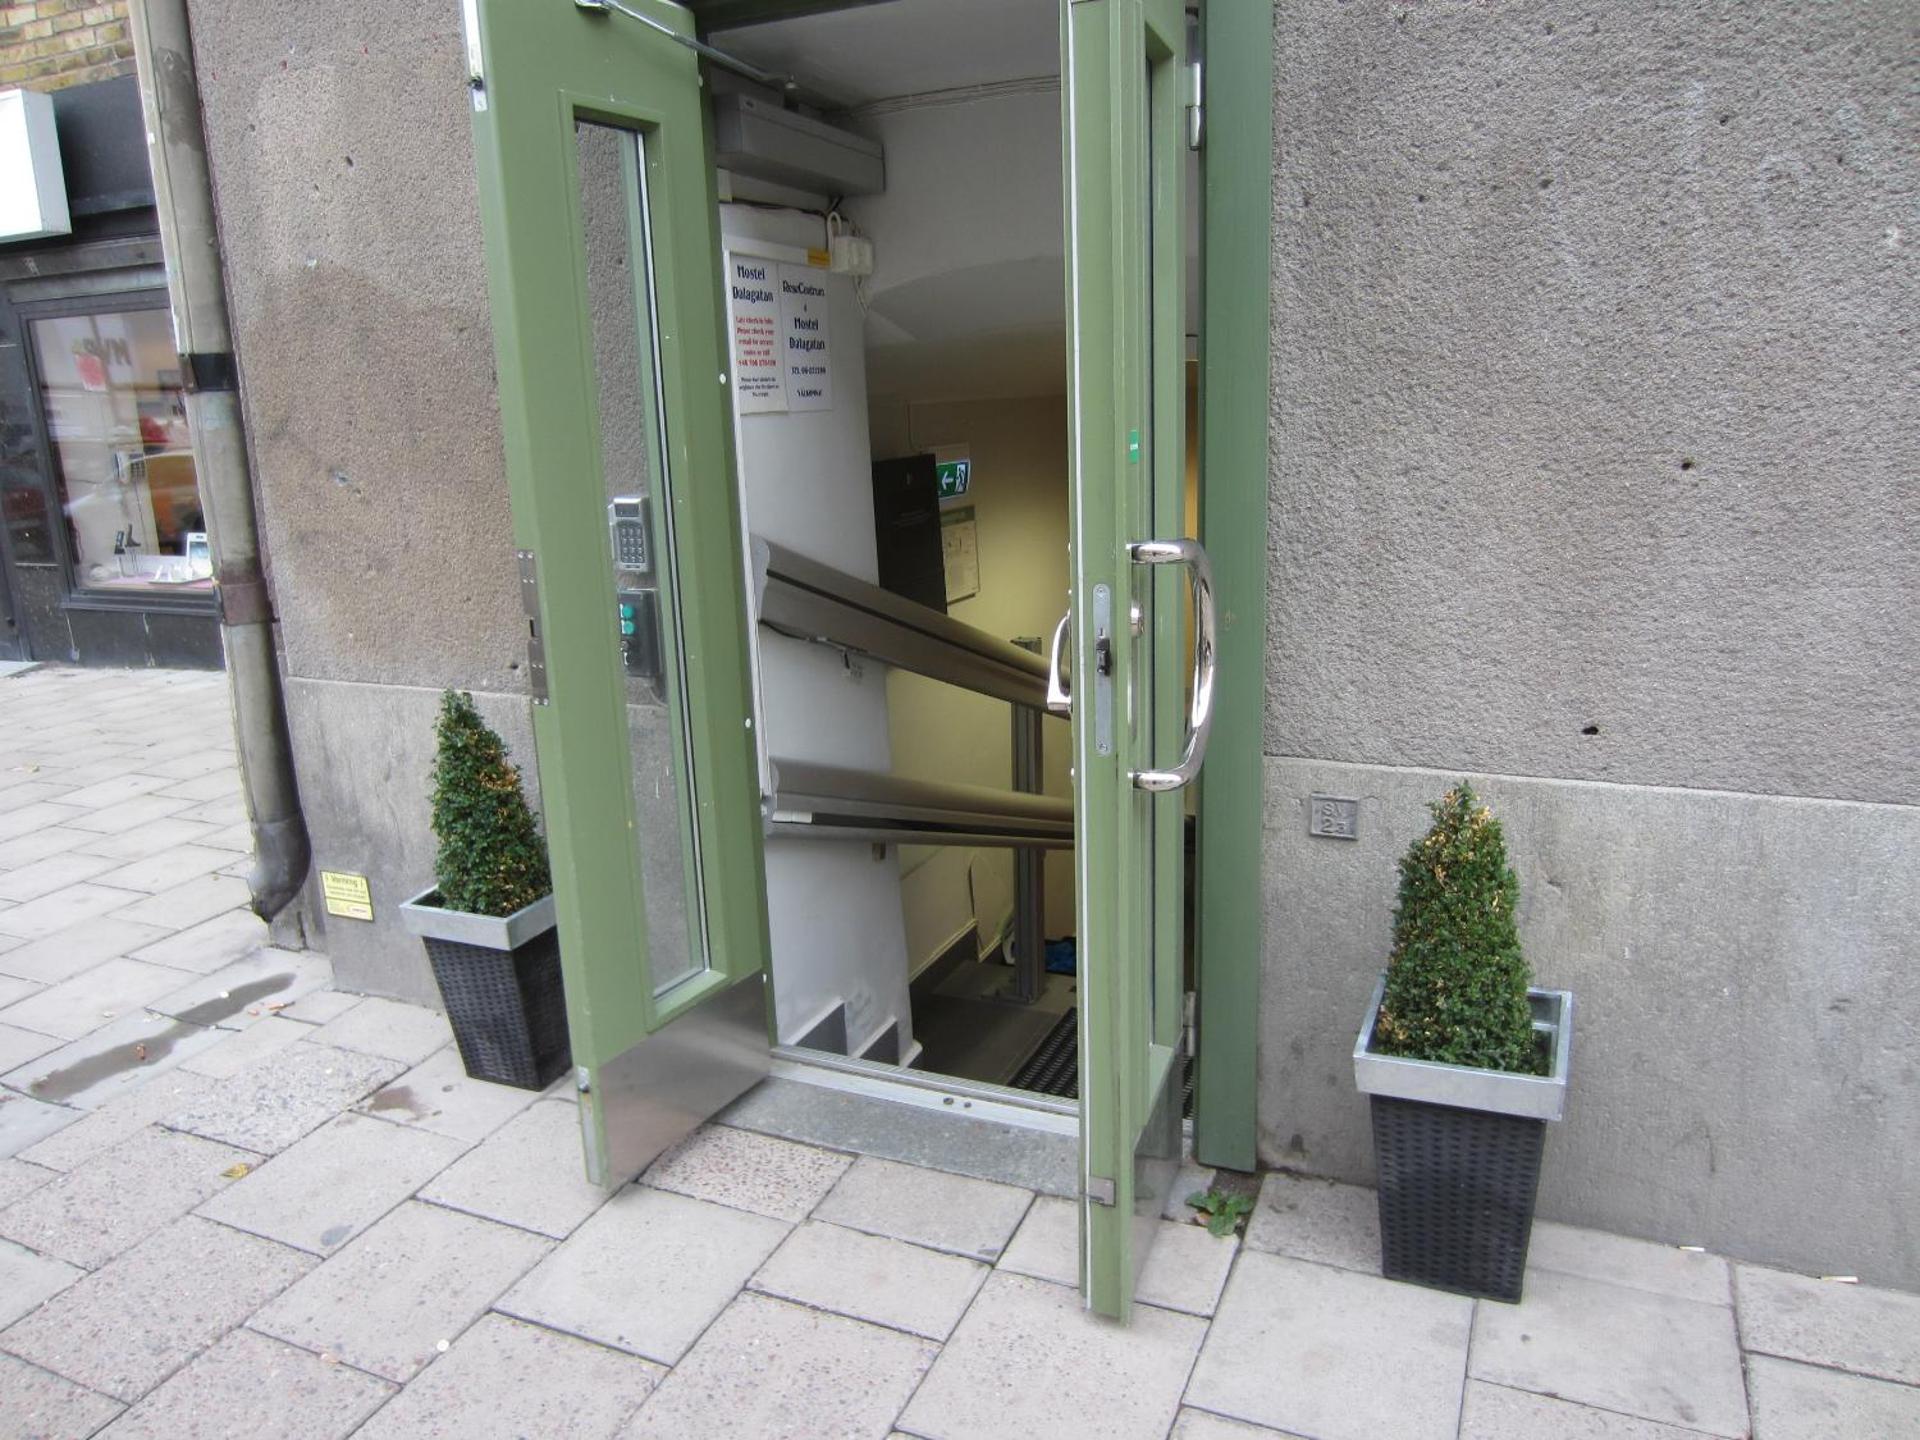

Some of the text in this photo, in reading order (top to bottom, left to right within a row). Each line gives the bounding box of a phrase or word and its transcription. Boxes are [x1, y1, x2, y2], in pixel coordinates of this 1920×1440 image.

[737, 264, 765, 280] Hostel
[733, 286, 774, 304] Dalagatan
[794, 317, 819, 331] Hostel
[789, 336, 825, 352] Dalagatan
